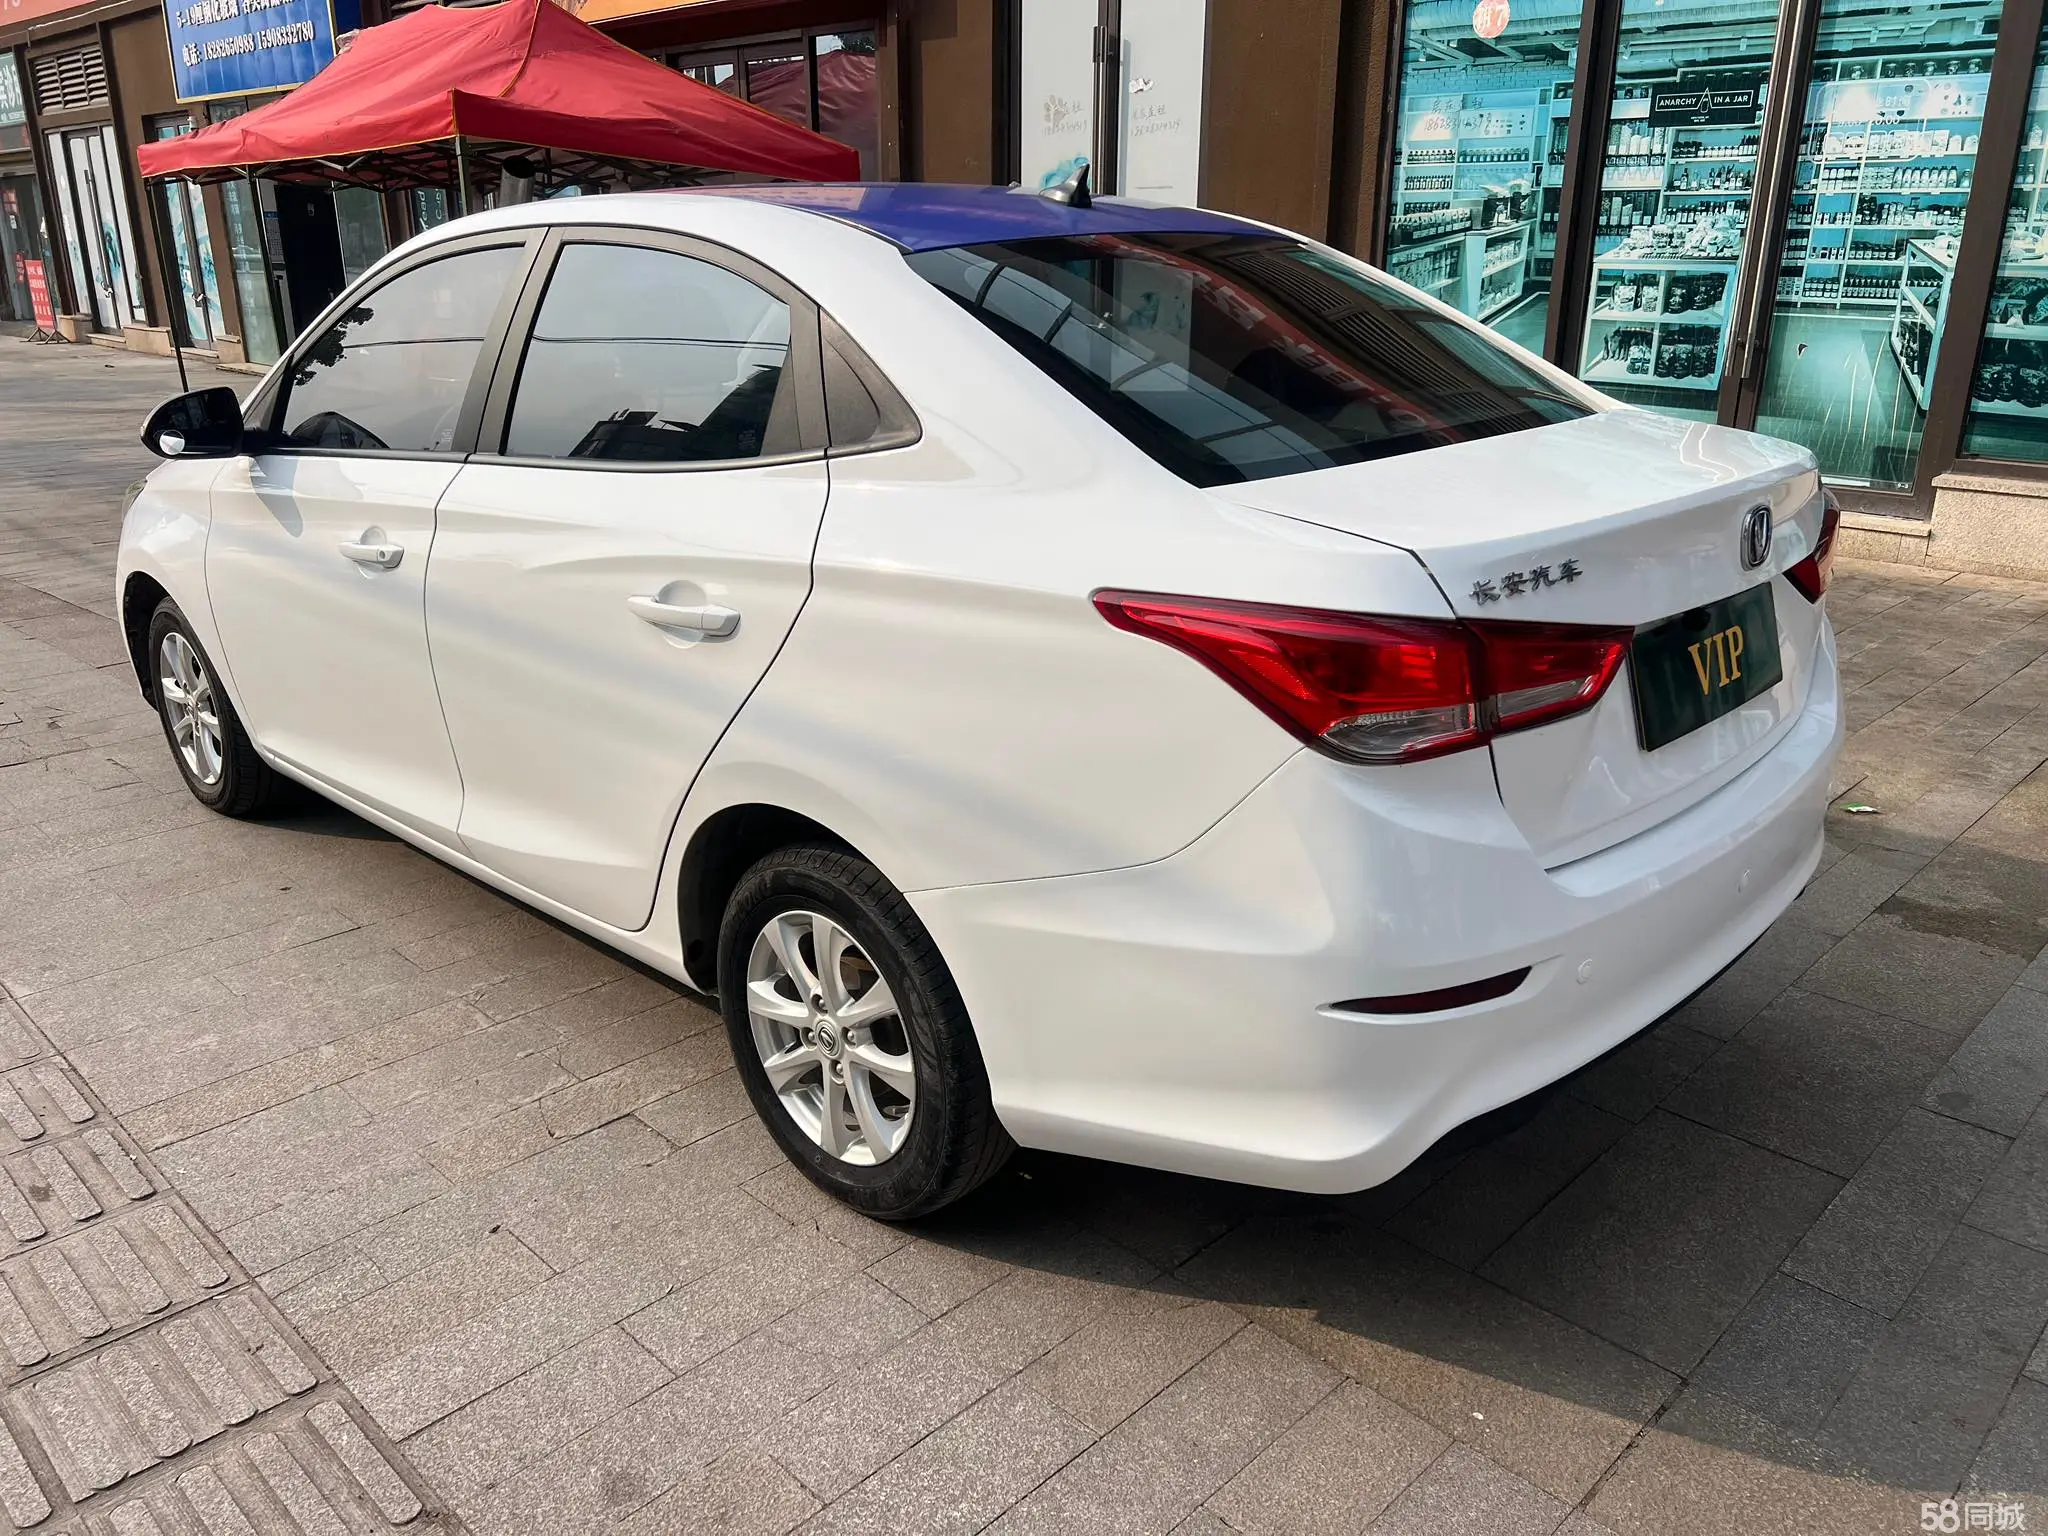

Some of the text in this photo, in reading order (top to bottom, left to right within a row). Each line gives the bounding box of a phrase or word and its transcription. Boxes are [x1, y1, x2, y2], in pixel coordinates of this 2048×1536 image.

[1659, 98, 1697, 106] ANARCHY
[1733, 95, 1749, 103] JAR
[1469, 558, 1583, 606] 长安汽车
[1688, 625, 1744, 695] VIP
